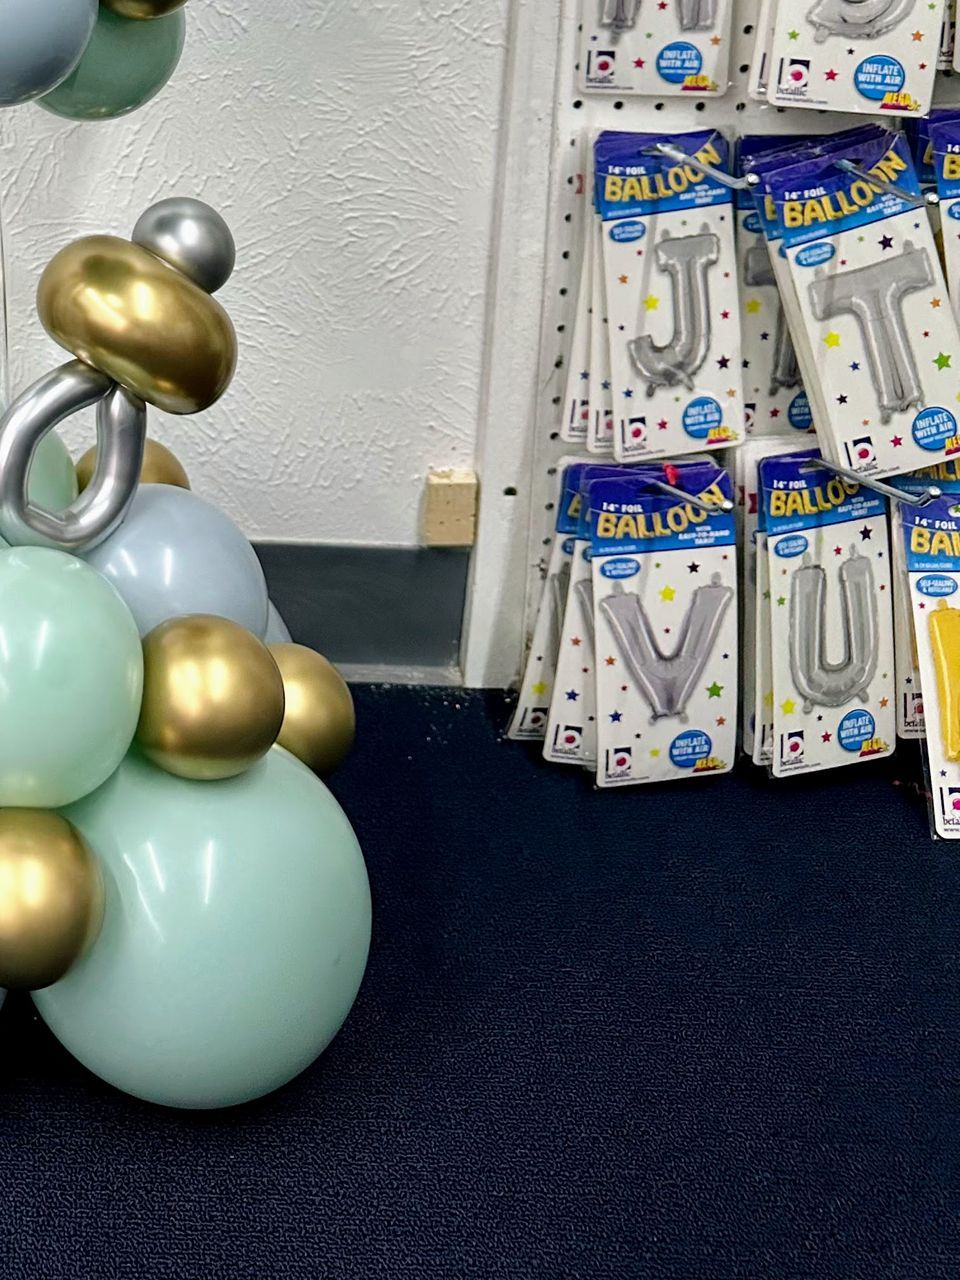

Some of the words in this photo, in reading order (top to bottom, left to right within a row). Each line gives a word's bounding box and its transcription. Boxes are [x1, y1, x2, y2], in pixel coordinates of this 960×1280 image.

[662, 50, 697, 59] INFLATE
[659, 59, 682, 68] WITH
[683, 59, 700, 68] AIR
[862, 63, 899, 75] INFLATE
[858, 74, 882, 84] WITH
[883, 74, 902, 85] AIR
[626, 166, 646, 175] FOIL
[803, 186, 827, 199] FOIL
[916, 412, 949, 430] INFLATE
[914, 425, 938, 439] WITH
[939, 421, 954, 433] AIR
[788, 479, 808, 489] FOIL
[621, 504, 643, 514] FOIL
[935, 520, 957, 530] FOIL
[842, 716, 870, 729] INFLATE
[840, 727, 860, 739] WITH
[860, 724, 873, 735] AIR
[675, 736, 707, 747] INFLATE
[671, 746, 694, 755] WITH
[694, 744, 710, 754] AIR
